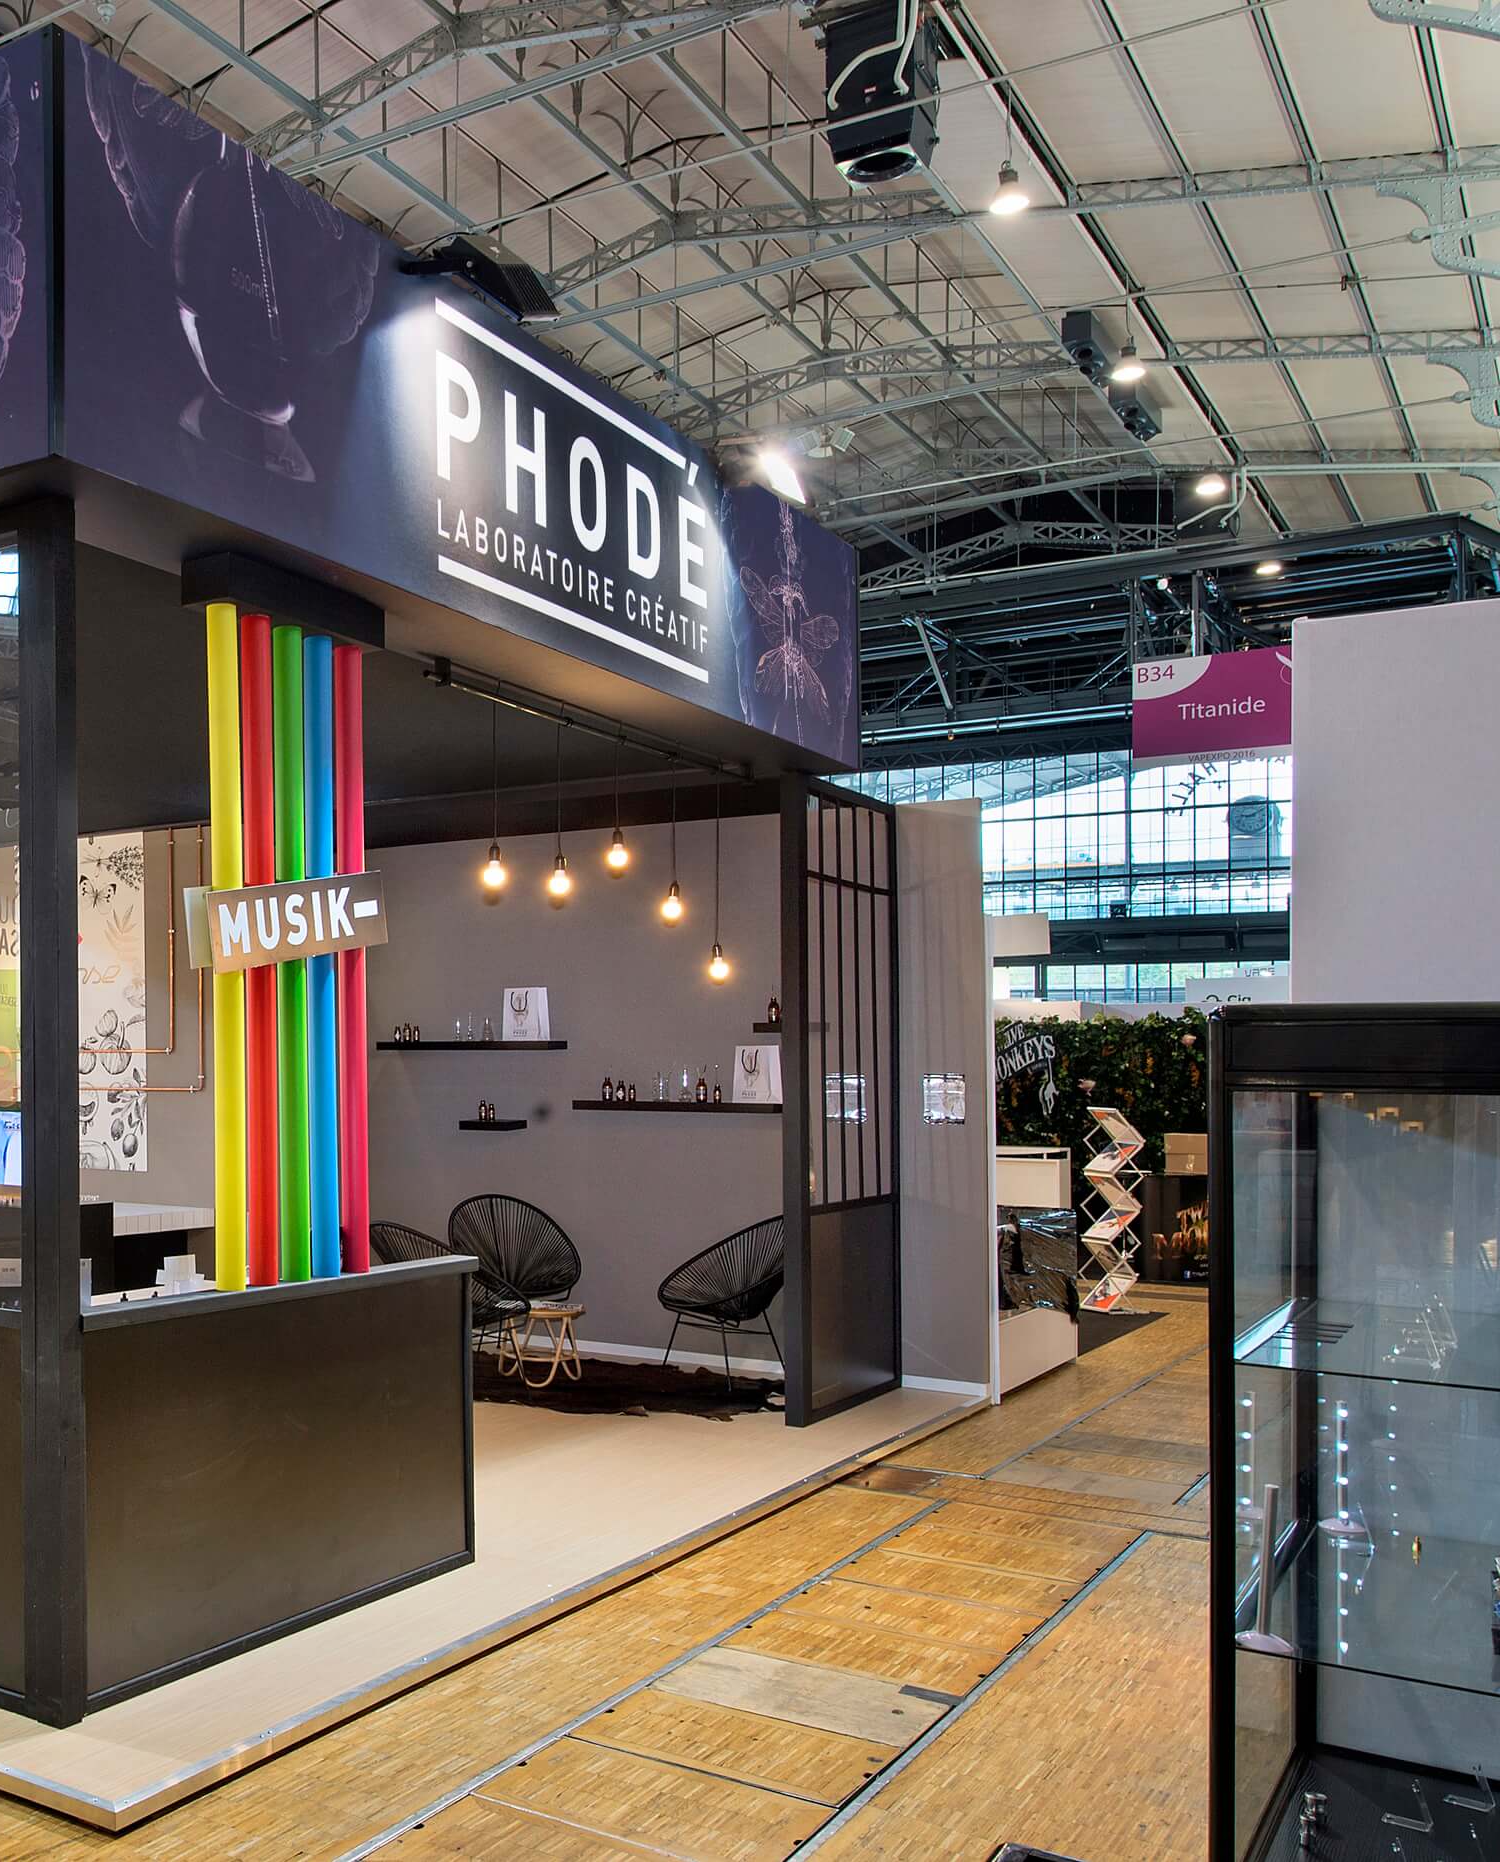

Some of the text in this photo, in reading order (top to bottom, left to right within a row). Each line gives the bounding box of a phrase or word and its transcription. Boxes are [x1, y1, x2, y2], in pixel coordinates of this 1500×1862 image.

[436, 350, 709, 609] PHODÉ
[436, 498, 710, 654] LABORATOIRE CRÉATIF
[1137, 664, 1175, 684] B34
[1178, 695, 1267, 721] Titanide
[1188, 750, 1256, 763] VAPEXPO 2016
[996, 1034, 1056, 1080] ONKEYS
